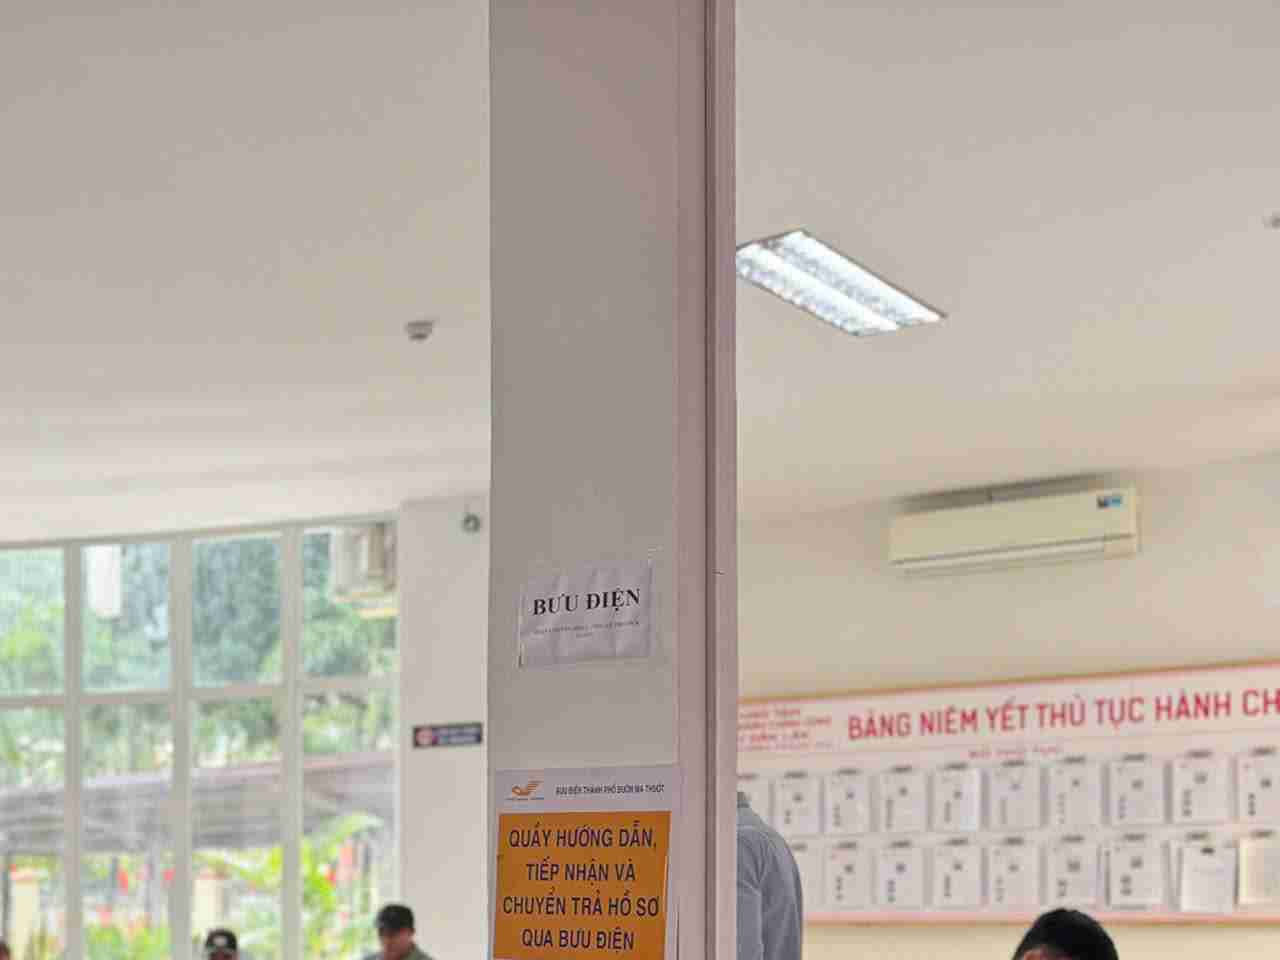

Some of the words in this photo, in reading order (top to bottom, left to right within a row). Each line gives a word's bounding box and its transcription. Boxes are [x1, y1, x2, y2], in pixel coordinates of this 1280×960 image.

[532, 593, 579, 616] BƯU
[586, 587, 641, 612] ĐIỆN
[847, 706, 913, 741] BẢNG
[919, 704, 979, 736] NIÊM
[985, 697, 1029, 732] YẾT
[1035, 692, 1087, 728] THỦ
[1093, 695, 1146, 730] TỤC
[1154, 687, 1232, 720] HÀNH
[556, 825, 613, 848] HƯỚNG
[526, 856, 560, 881] TIẾP
[565, 857, 609, 886] NHẬN
[503, 886, 566, 915] CHUYỂN
[572, 889, 602, 916] TRẢ
[636, 896, 660, 917] SƠ
[522, 928, 553, 948] QUA
[559, 929, 591, 949] BƯU
[596, 926, 634, 954] ĐIỆN
